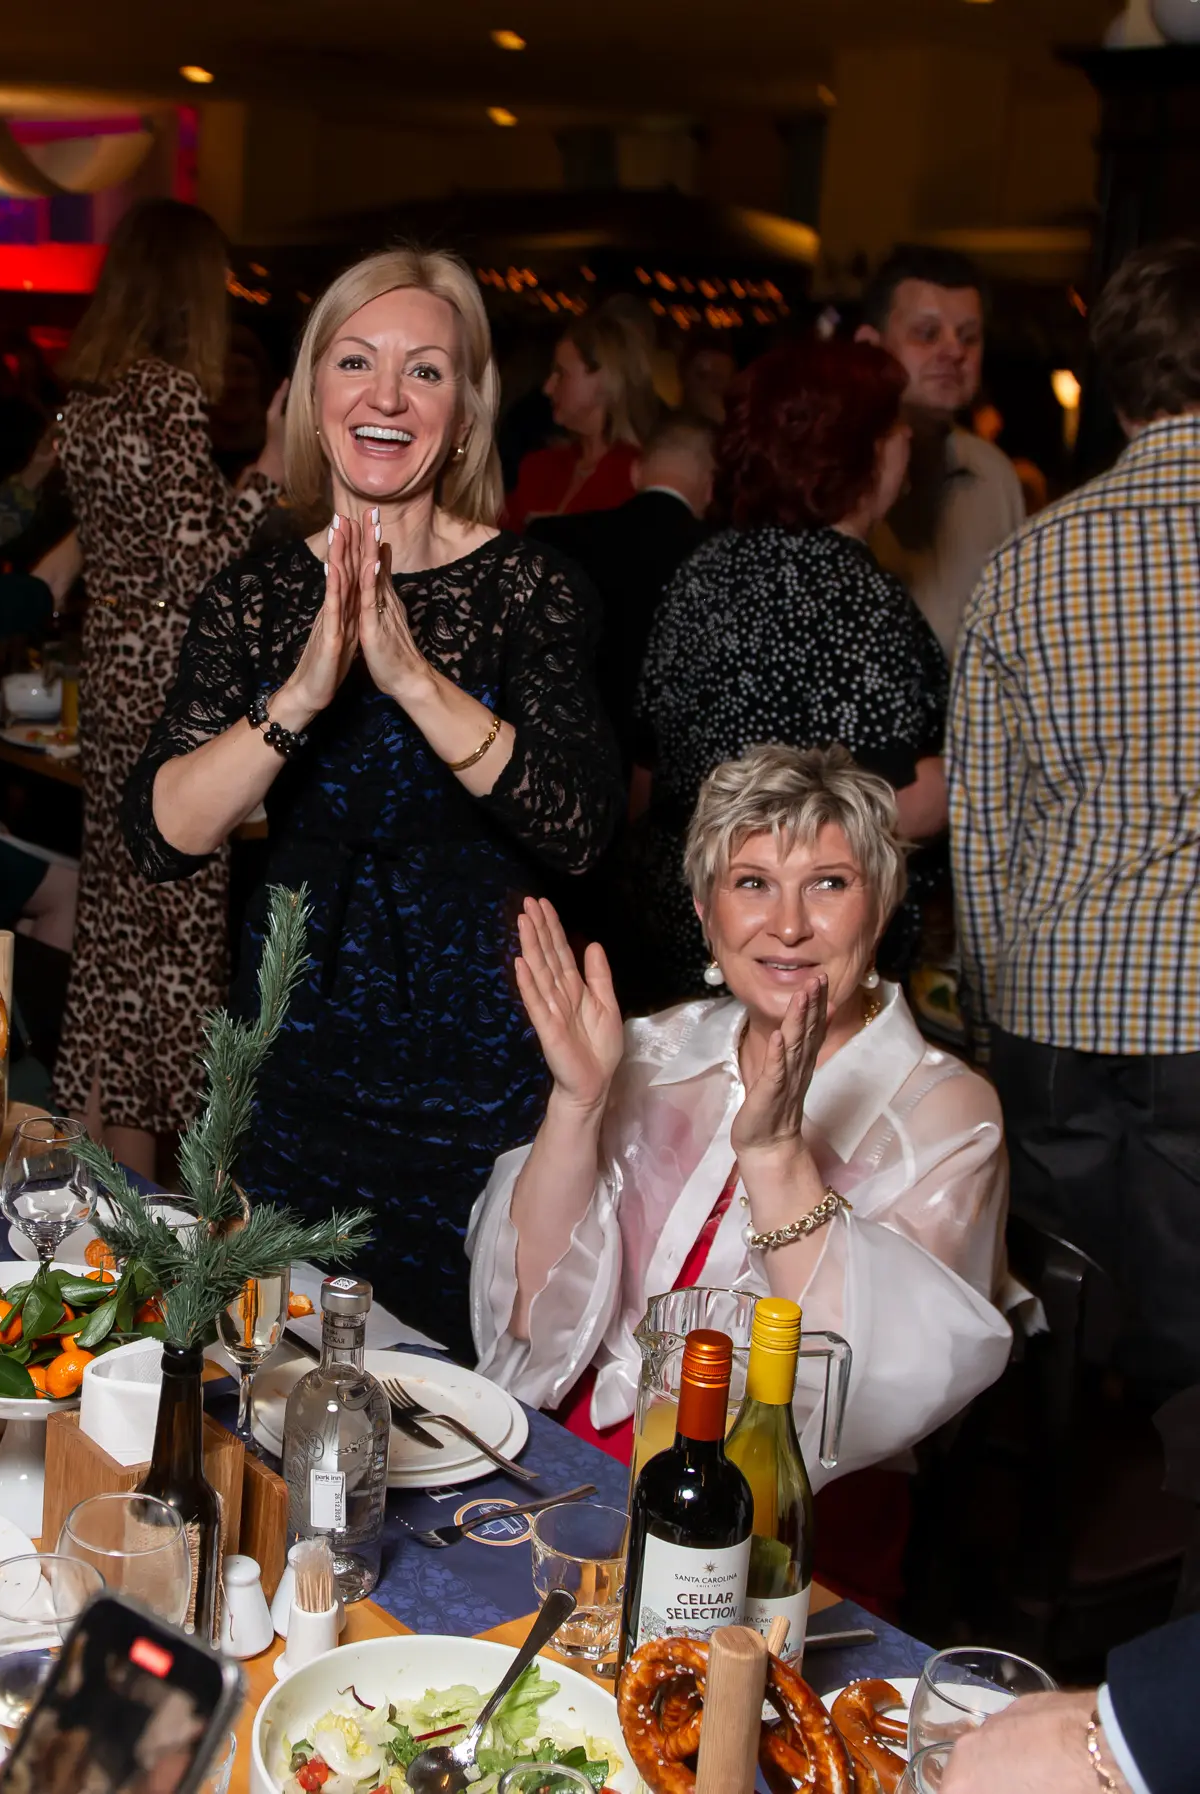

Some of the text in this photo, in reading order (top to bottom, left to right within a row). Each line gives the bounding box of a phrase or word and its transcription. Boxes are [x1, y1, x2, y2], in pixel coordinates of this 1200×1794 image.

[674, 1572, 738, 1584] SANTA CAROLINA
[676, 1592, 734, 1605] CELLAR
[666, 1606, 738, 1620] SELECTION
